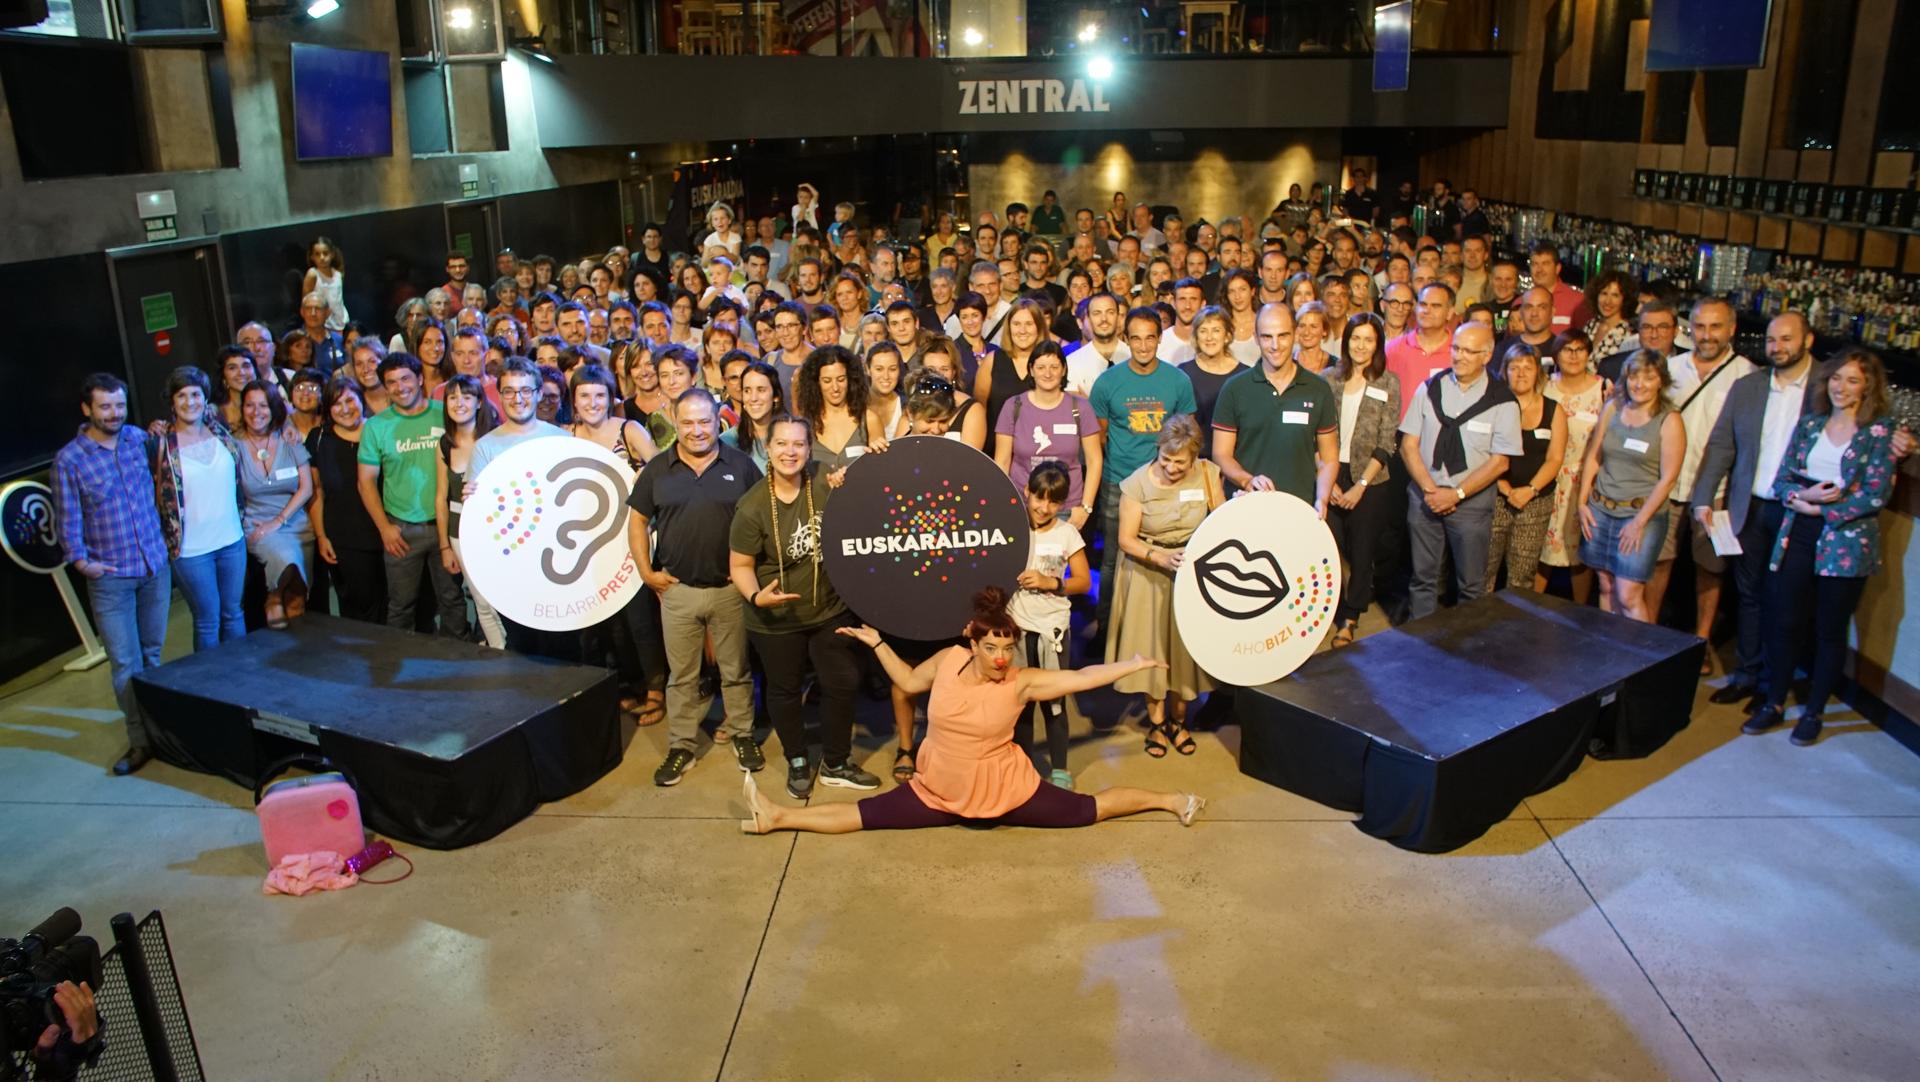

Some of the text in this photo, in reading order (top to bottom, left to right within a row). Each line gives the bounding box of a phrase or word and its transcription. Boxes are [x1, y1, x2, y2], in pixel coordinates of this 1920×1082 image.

[958, 79, 1110, 114] ZENTRAL
[841, 528, 1008, 556] EUSKARALDIA
[1232, 626, 1293, 655] AHOBIZI
